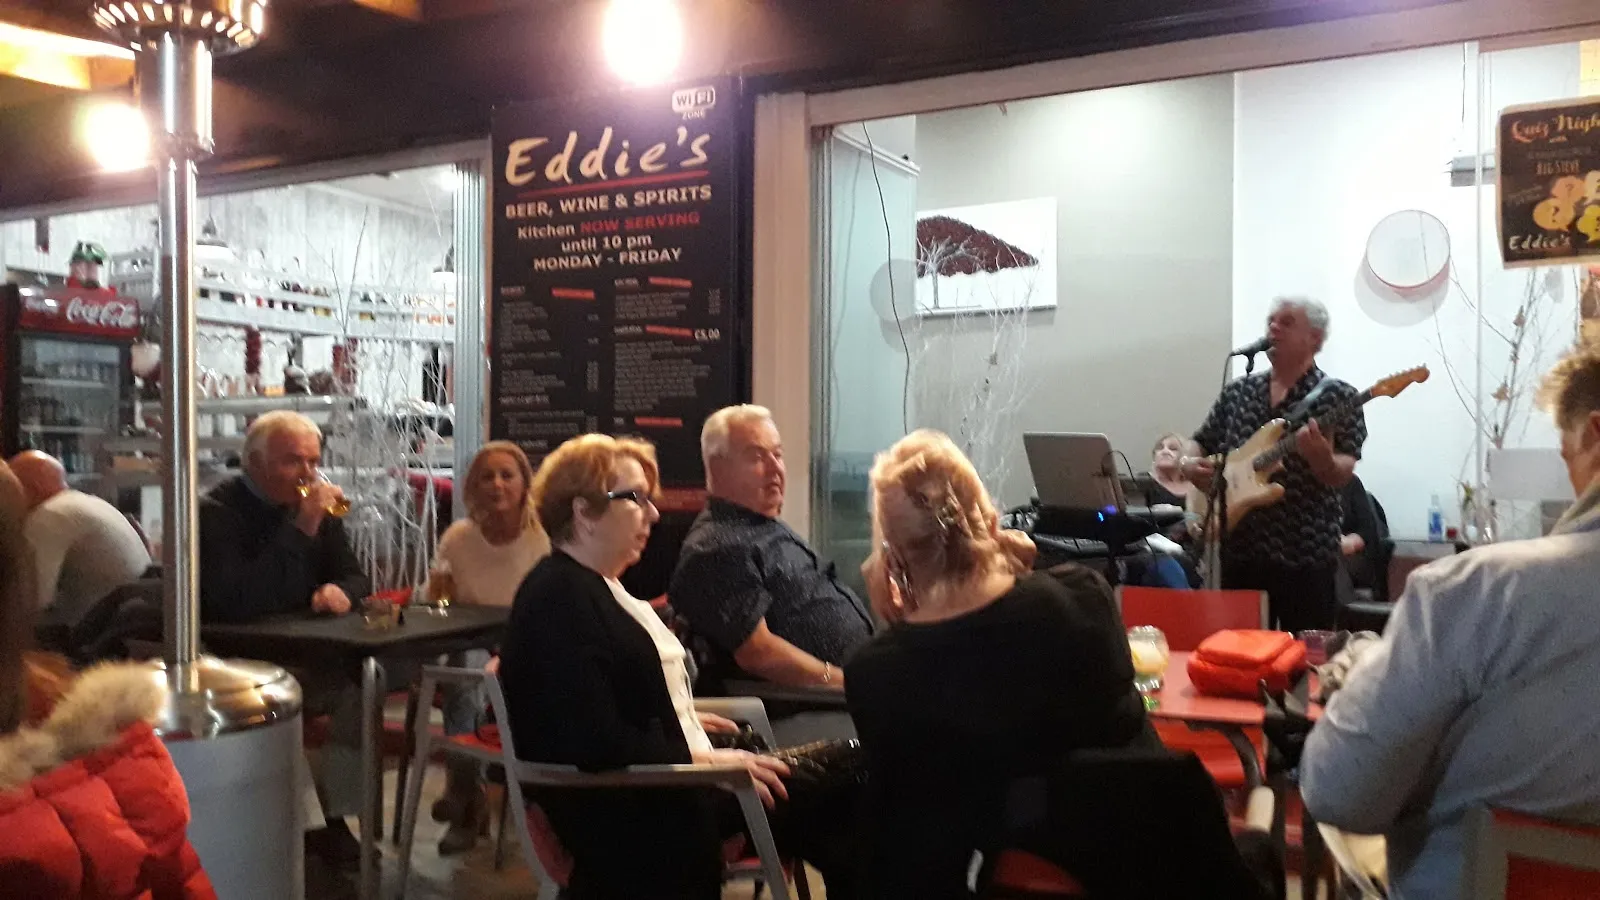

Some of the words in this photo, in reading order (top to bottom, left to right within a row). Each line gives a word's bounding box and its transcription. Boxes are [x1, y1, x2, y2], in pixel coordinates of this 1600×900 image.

[505, 126, 711, 186] Eddie's
[505, 202, 553, 219] BEER,
[559, 196, 609, 213] WINE
[615, 195, 628, 208] &
[634, 184, 712, 206] SPIRITS
[517, 223, 576, 240] Kitchen
[580, 218, 619, 234] NOW
[624, 211, 700, 231] SERVING
[560, 237, 597, 253] until
[602, 234, 623, 248] 10
[626, 233, 652, 249] pm
[1509, 234, 1571, 250] Eddie's
[533, 253, 602, 272] MONDAY
[619, 247, 682, 265] FRIDAY
